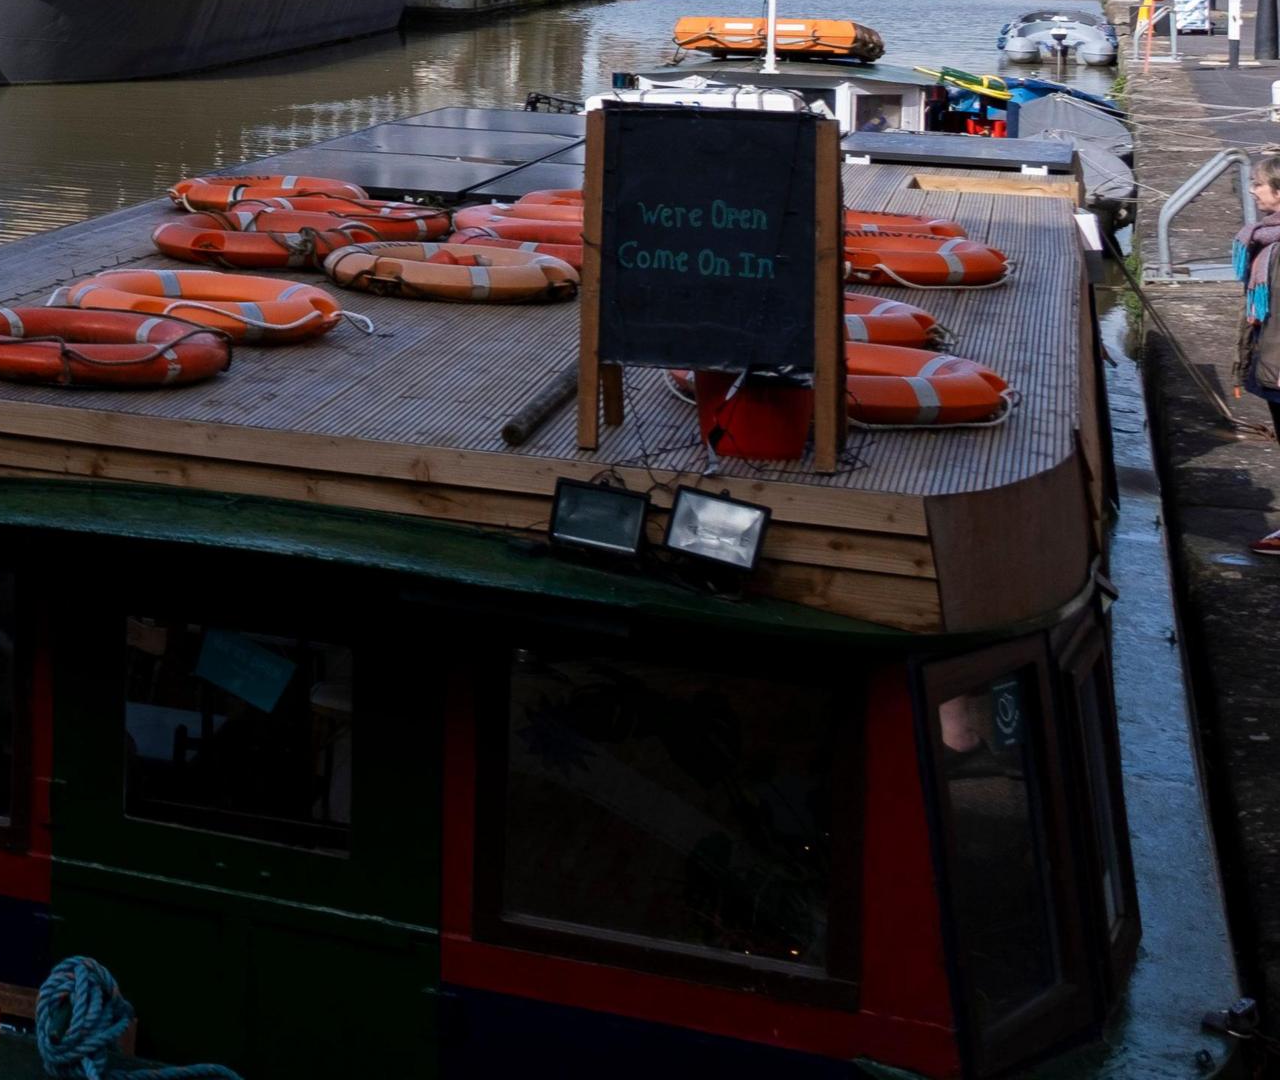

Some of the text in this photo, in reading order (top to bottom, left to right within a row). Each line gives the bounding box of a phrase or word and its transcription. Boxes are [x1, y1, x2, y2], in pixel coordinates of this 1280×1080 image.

[617, 240, 775, 279] Come On In
